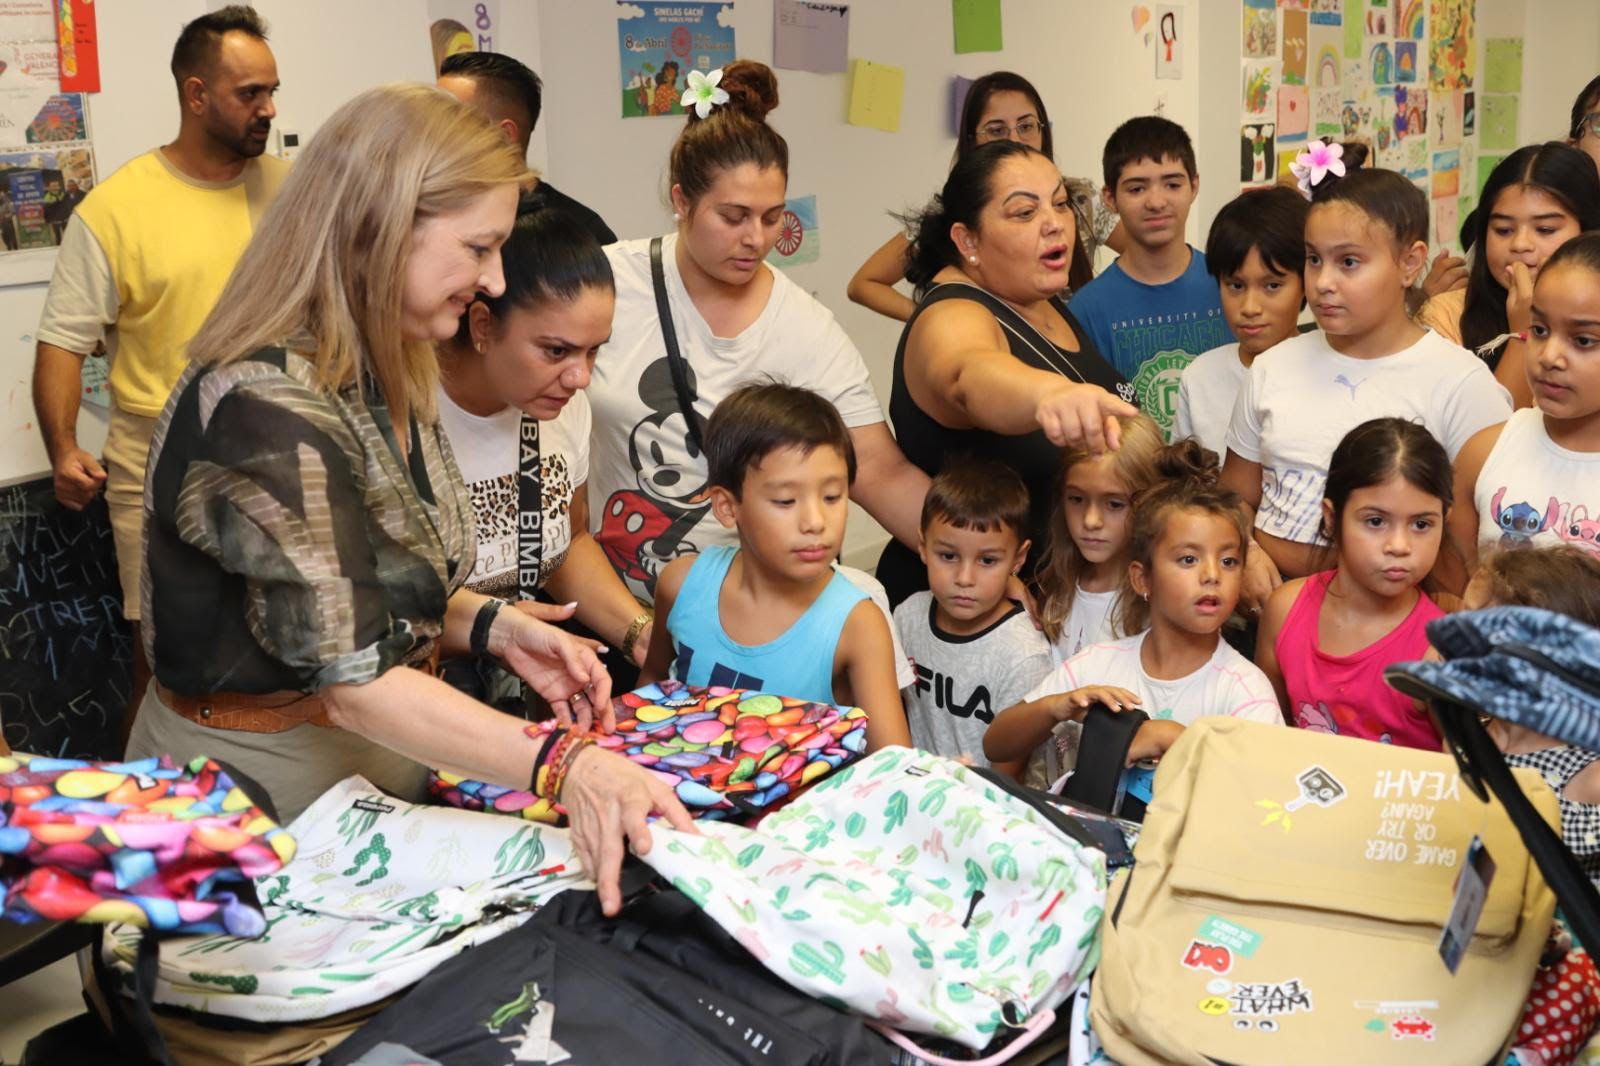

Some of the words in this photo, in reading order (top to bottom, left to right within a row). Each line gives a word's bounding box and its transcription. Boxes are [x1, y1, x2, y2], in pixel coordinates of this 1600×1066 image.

[625, 34, 634, 49] 8
[1112, 311, 1197, 331] UNIVERSITY
[521, 422, 540, 483] BAY
[912, 663, 995, 725] FILA
[1373, 769, 1460, 801] YEAH!
[1380, 801, 1435, 822] AGAIN?
[1376, 820, 1406, 840] TRY
[1414, 822, 1437, 842] OR
[1364, 839, 1408, 862] OVER
[1414, 843, 1458, 868] GAME
[1237, 980, 1301, 998] EVER
[1231, 992, 1310, 1014] WHAT
